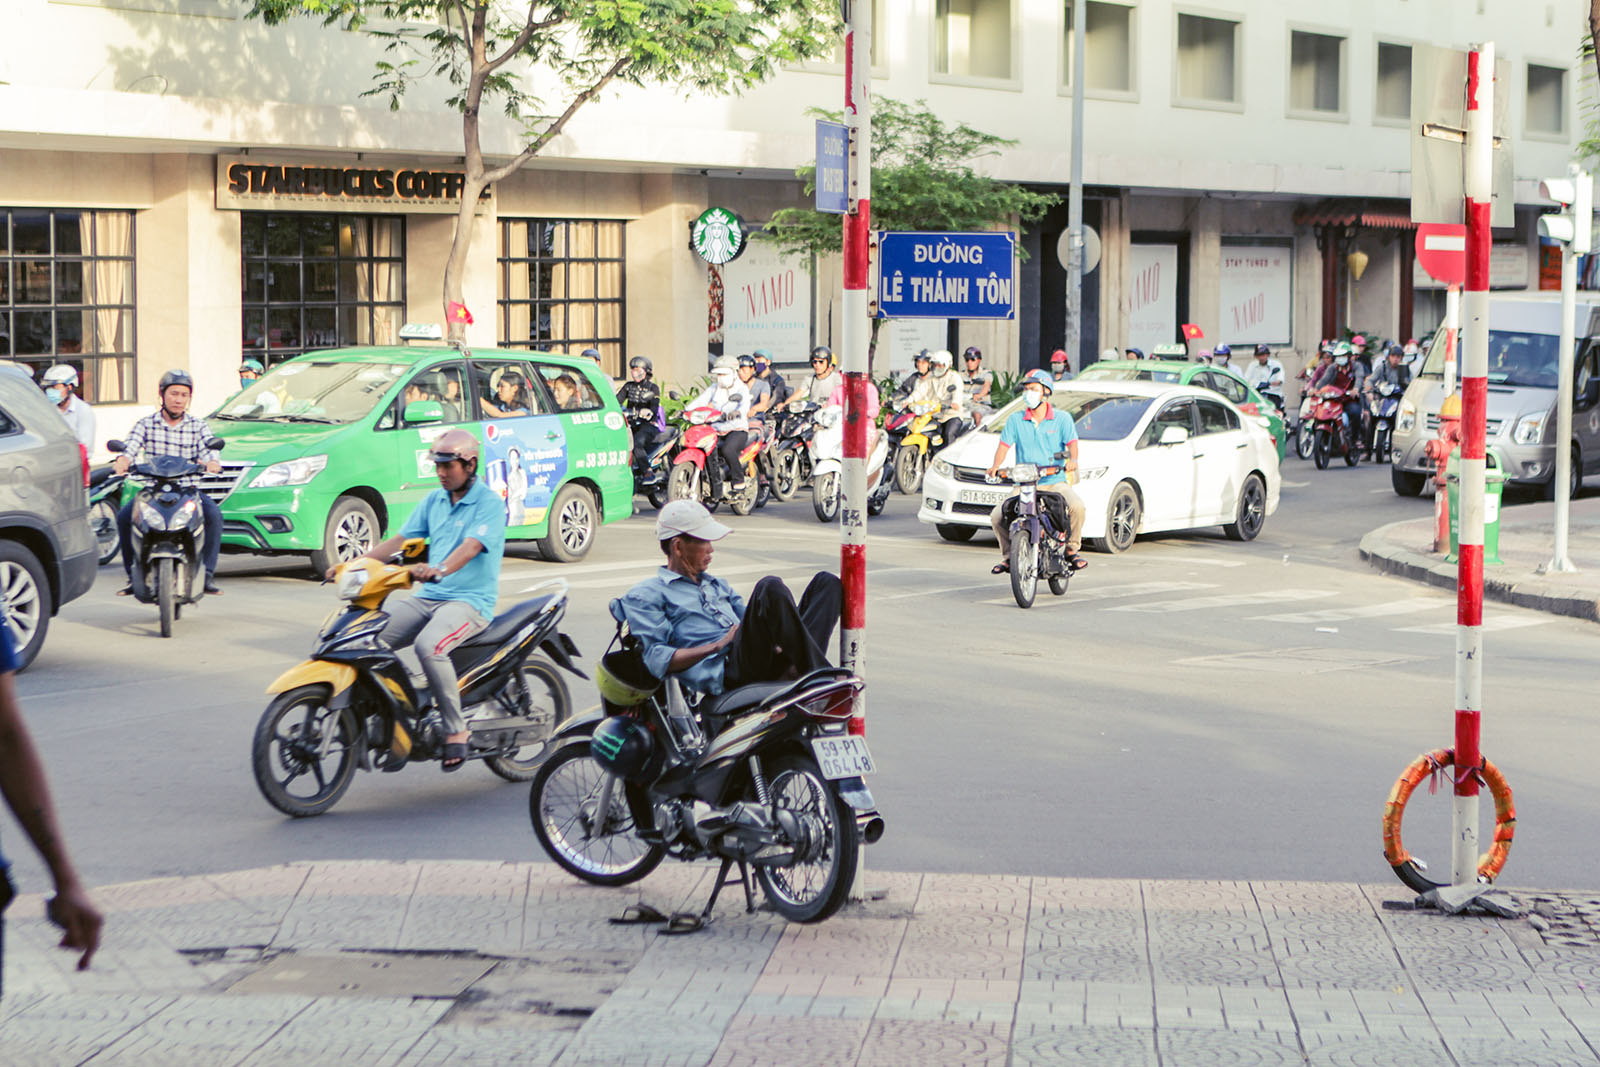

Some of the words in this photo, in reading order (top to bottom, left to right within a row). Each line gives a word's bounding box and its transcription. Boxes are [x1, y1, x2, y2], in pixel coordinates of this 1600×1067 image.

[228, 163, 394, 197] STARBUCKS
[395, 167, 491, 199] COFF
[914, 237, 983, 264] ĐƯỜNG
[1225, 258, 1243, 268] STAY
[882, 270, 904, 302] LÊ
[910, 270, 969, 303] THÁNH
[976, 272, 1011, 305] TÔN
